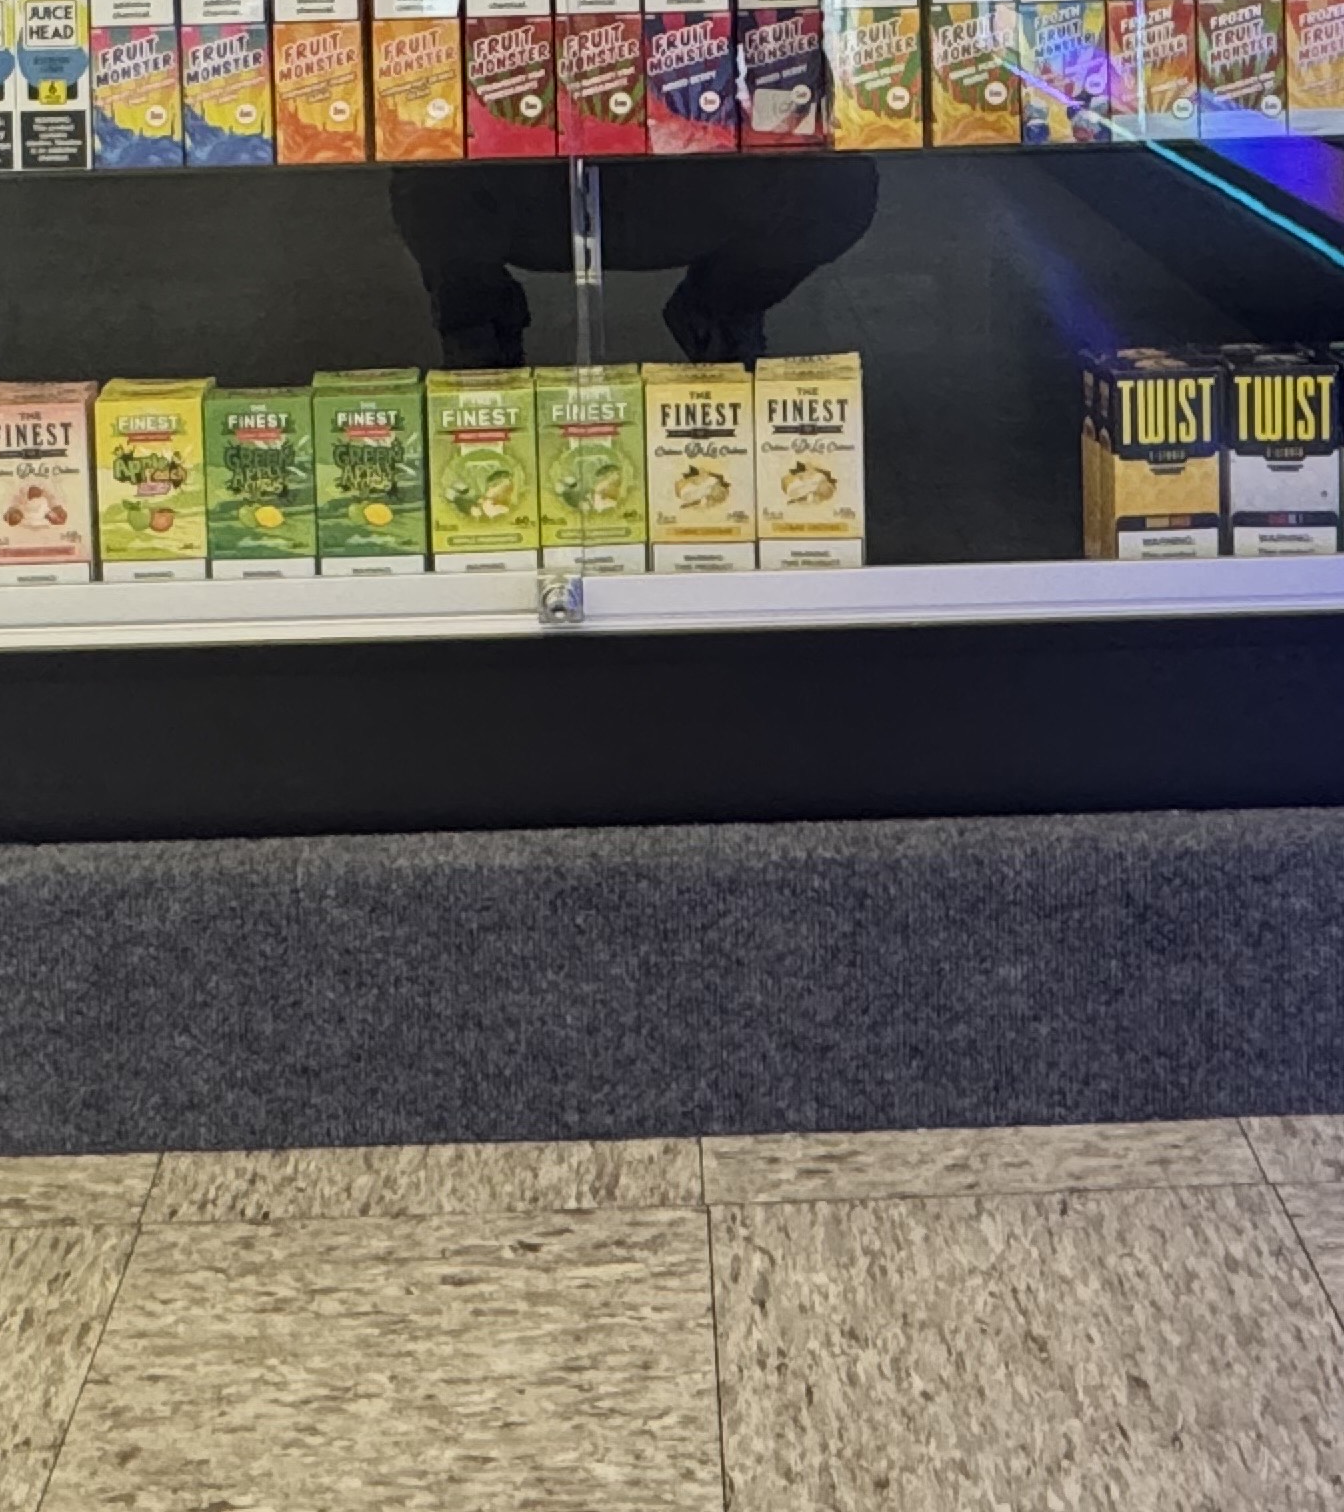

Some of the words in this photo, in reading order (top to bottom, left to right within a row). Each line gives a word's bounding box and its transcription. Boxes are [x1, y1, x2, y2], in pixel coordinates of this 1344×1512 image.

[28, 5, 74, 22] JUICE
[1209, 5, 1263, 30] FROZEN
[29, 23, 74, 41] HEAD
[283, 34, 340, 64] FRUIT
[383, 29, 442, 62] FRUIT
[472, 26, 534, 61] FRUIT
[561, 23, 624, 60] FRUIT
[651, 21, 713, 56] FRUIT
[743, 17, 804, 53] FRUIT
[1209, 35, 1277, 63] MONSTER
[1210, 21, 1264, 50] FRUIT
[100, 36, 156, 70] FRUIT
[185, 50, 263, 86] MONSTER
[190, 35, 248, 70] FRUIT
[278, 47, 357, 84] MONSTER
[377, 46, 457, 81] MONSTER
[468, 41, 552, 79] MONSTER
[558, 41, 641, 77] MONSTER
[647, 38, 730, 76] MONSTER
[742, 33, 819, 69] MONSTER
[96, 52, 173, 88] MONSTER
[117, 416, 179, 433] FINEST
[227, 412, 288, 429] FINEST
[337, 410, 398, 427] FINEST
[441, 407, 521, 428] FINEST
[551, 402, 629, 423] FINEST
[660, 403, 742, 428] FINEST
[767, 398, 849, 424] FINEST
[1116, 376, 1216, 445] TWIST
[1233, 374, 1335, 442] TWIST
